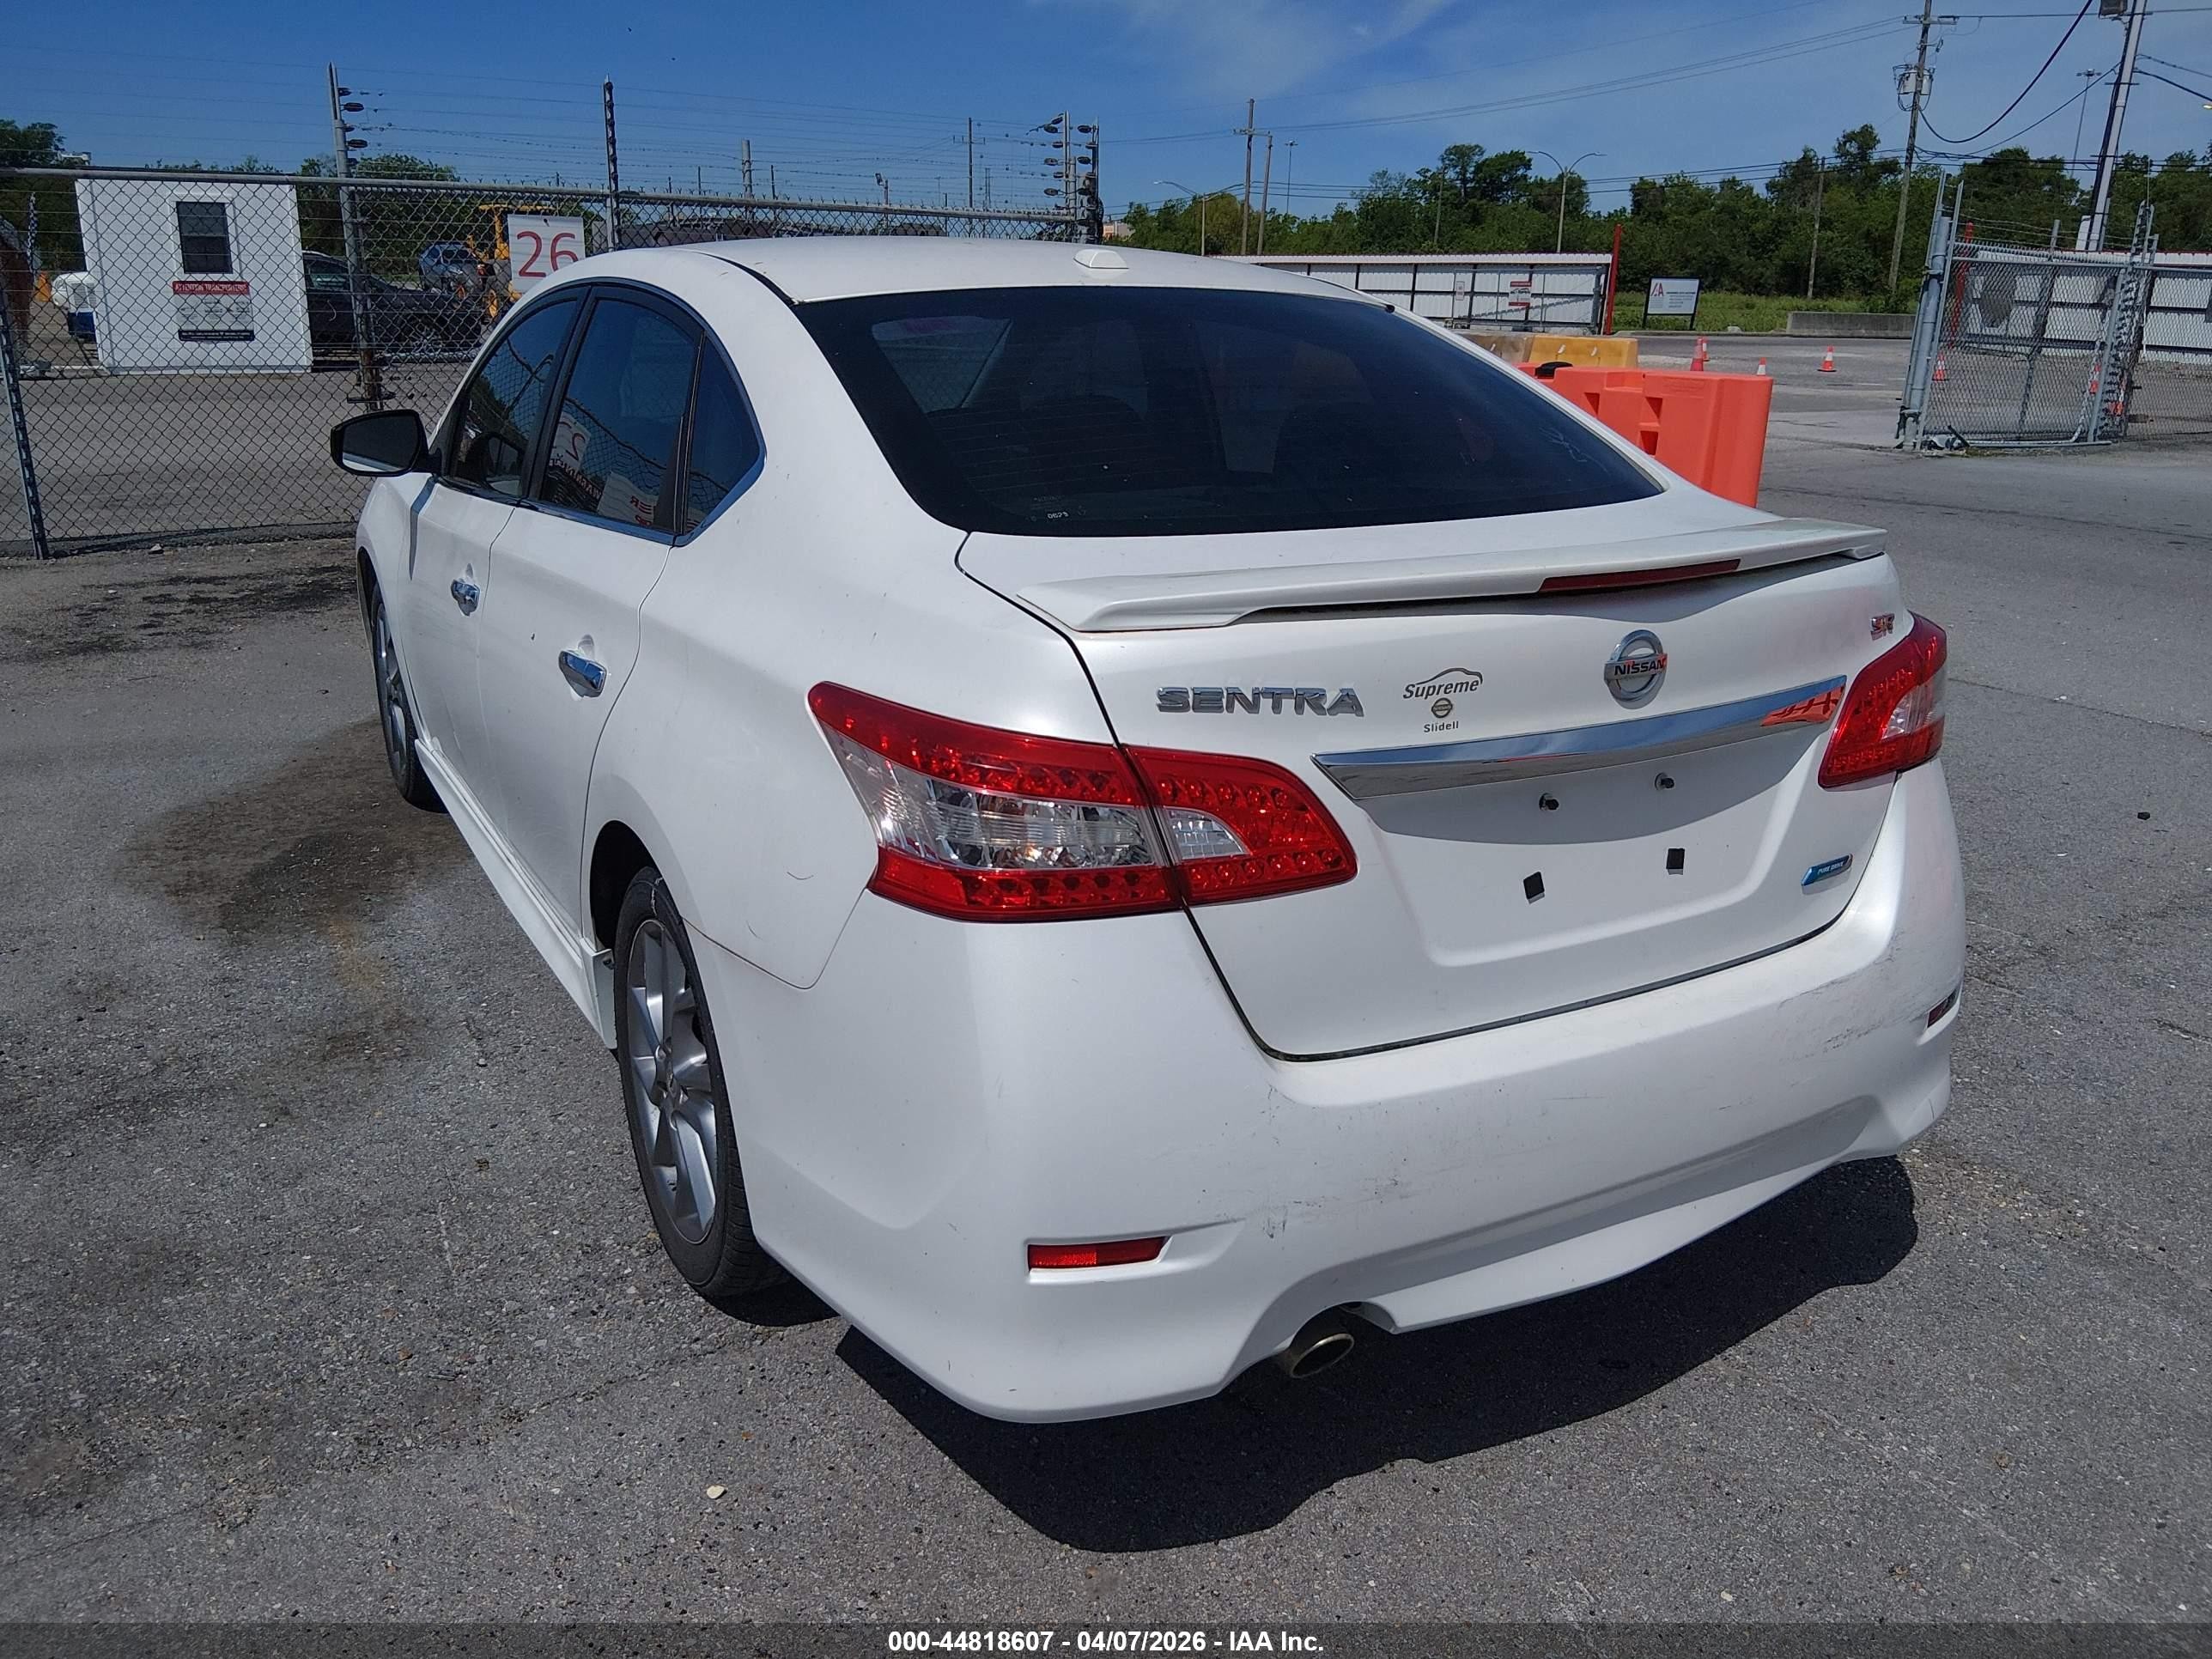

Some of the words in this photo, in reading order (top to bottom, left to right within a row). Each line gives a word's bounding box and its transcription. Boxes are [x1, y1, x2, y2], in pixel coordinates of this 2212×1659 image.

[517, 230, 579, 277] 26
[1613, 656, 1667, 677] NISSAN
[1402, 678, 1480, 701] Supreme
[1157, 686, 1365, 718] SENTRA
[1423, 720, 1460, 733] Slidell
